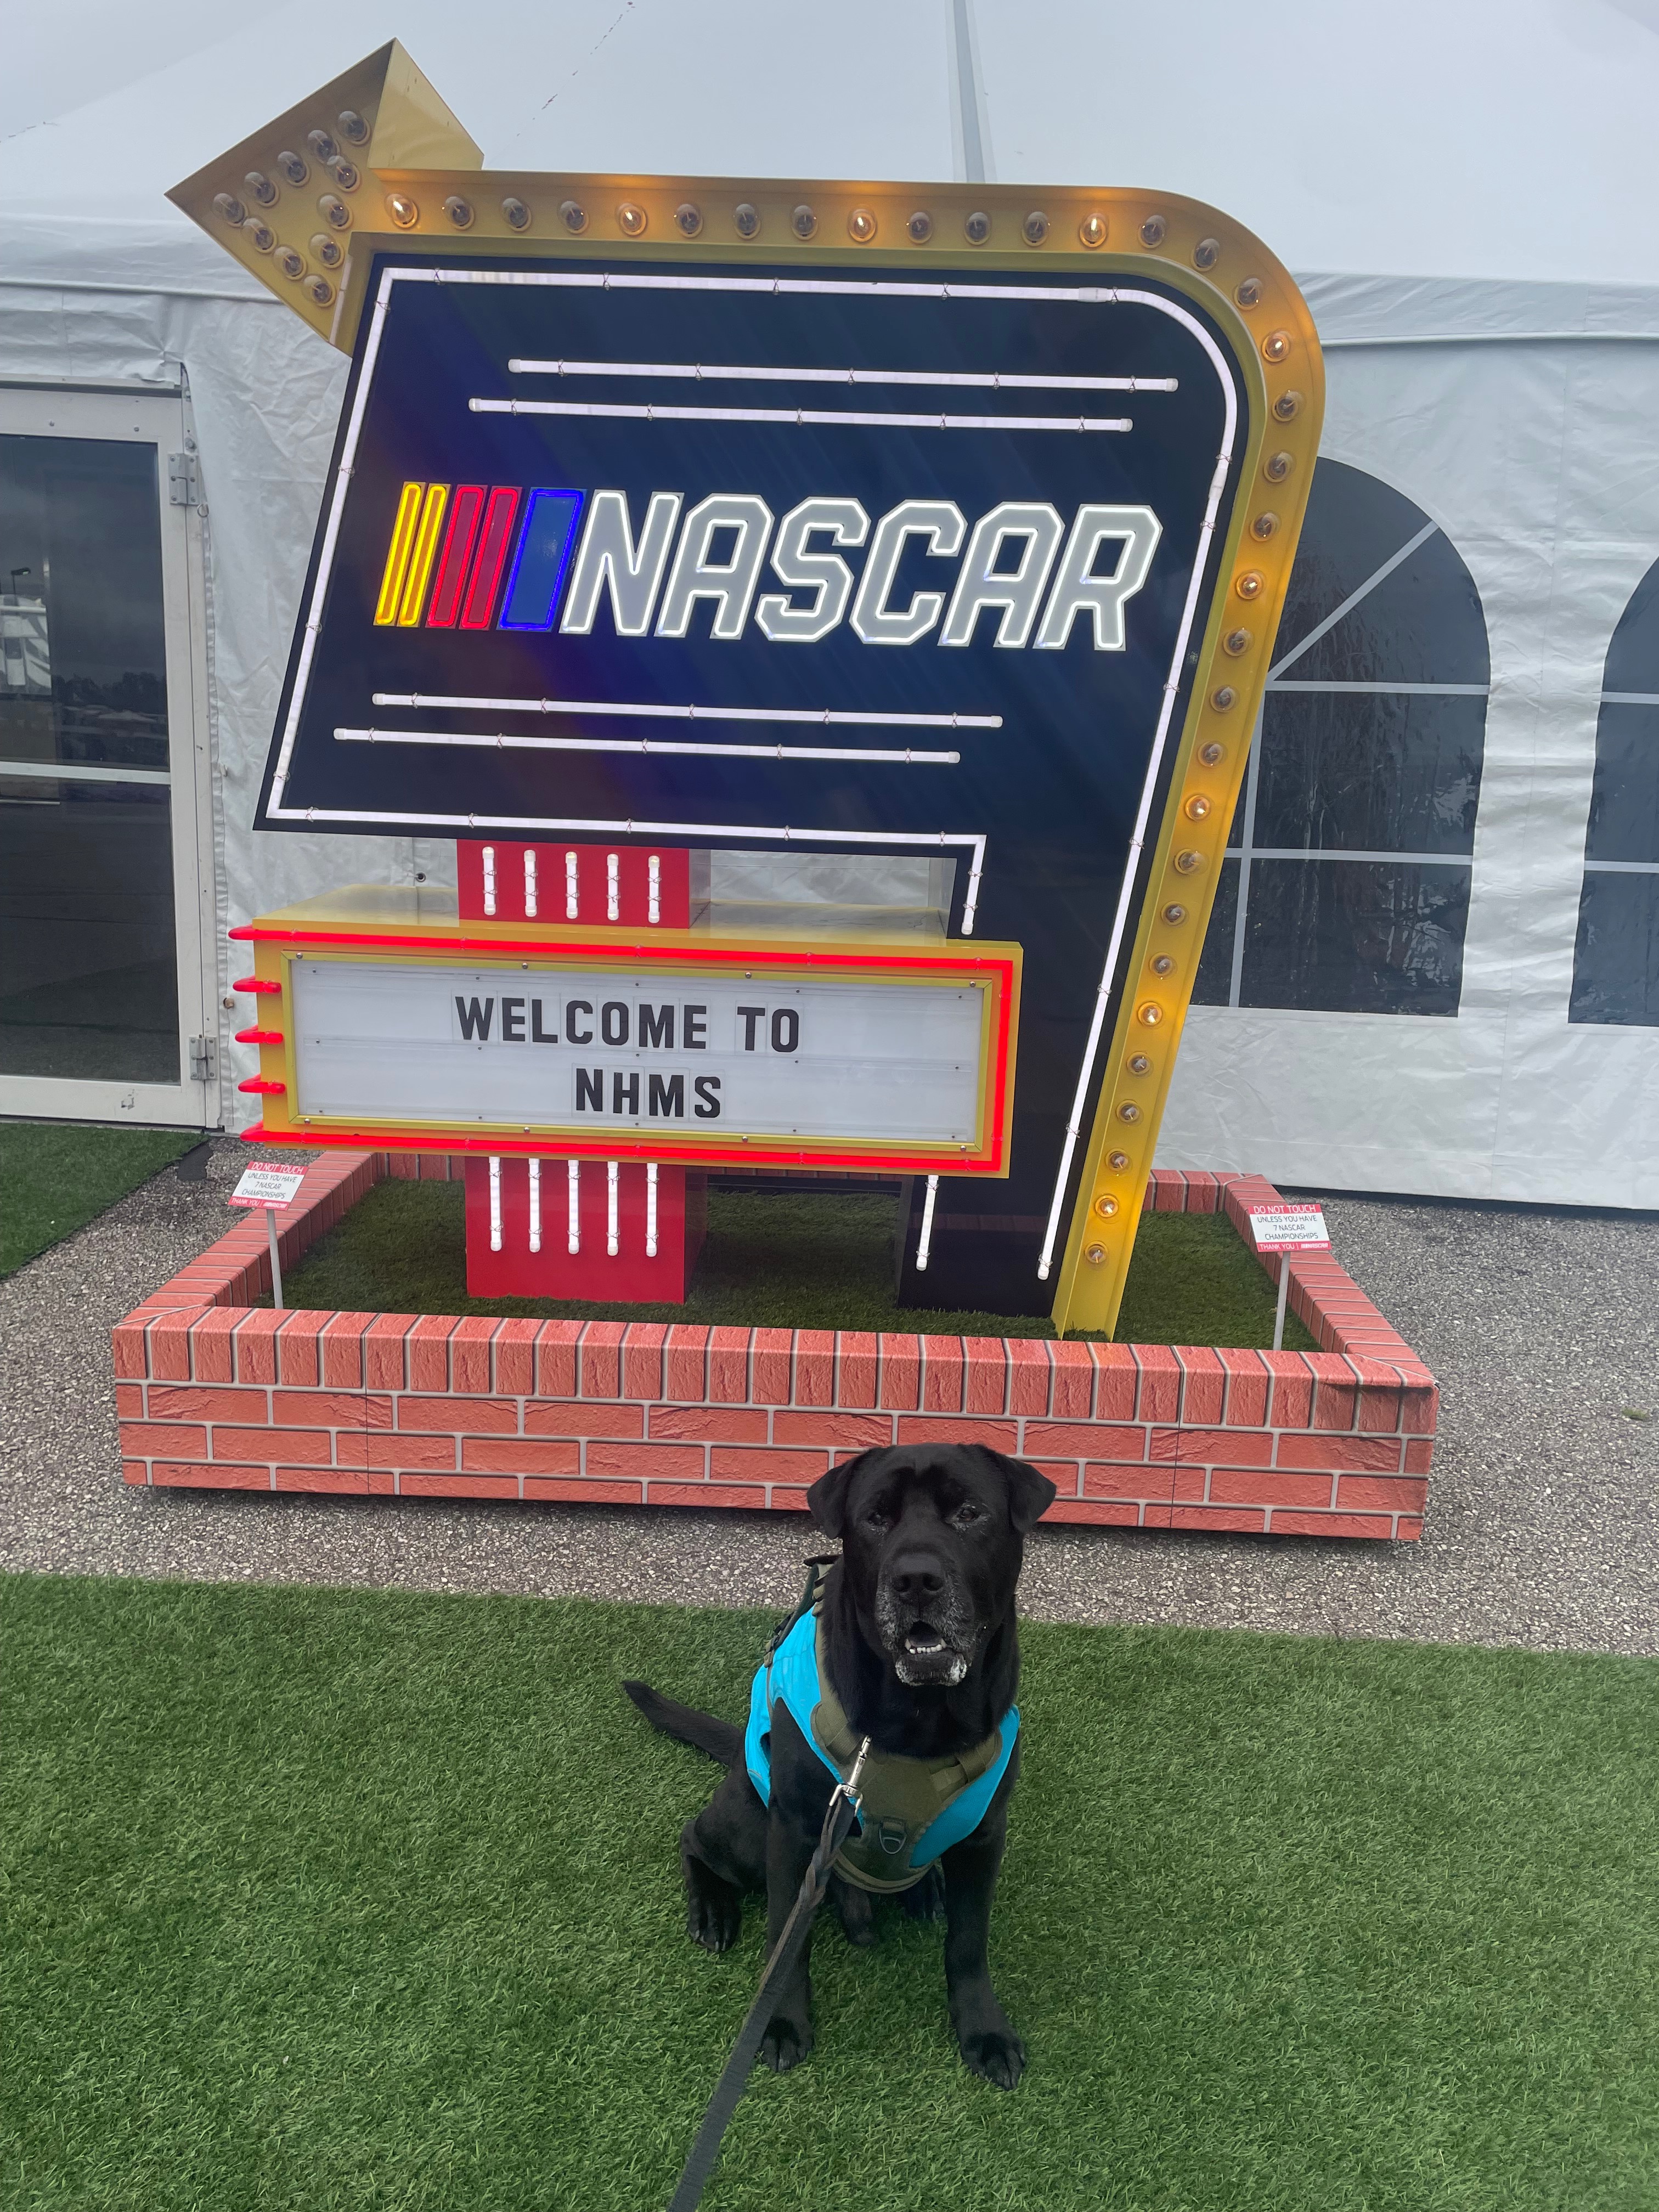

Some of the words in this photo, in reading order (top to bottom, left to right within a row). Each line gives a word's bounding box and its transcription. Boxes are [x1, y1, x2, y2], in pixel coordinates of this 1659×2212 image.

[559, 488, 1163, 651] NASCAR
[455, 996, 707, 1049] WELCOME
[737, 1006, 799, 1052] TO
[576, 1068, 721, 1118] NHMS
[251, 1162, 263, 1170] DO
[263, 1163, 280, 1172] NOT
[279, 1164, 304, 1174] TOUCH
[248, 1172, 269, 1180] UNLESS
[281, 1175, 298, 1183] HAVE
[241, 1188, 286, 1199] CHAMPIONSHIPS
[1253, 1205, 1266, 1214] DO
[1267, 1205, 1285, 1214] NOT
[1286, 1204, 1316, 1214] TOUCH
[1265, 1232, 1319, 1240] CHAMPIONSHIPS
